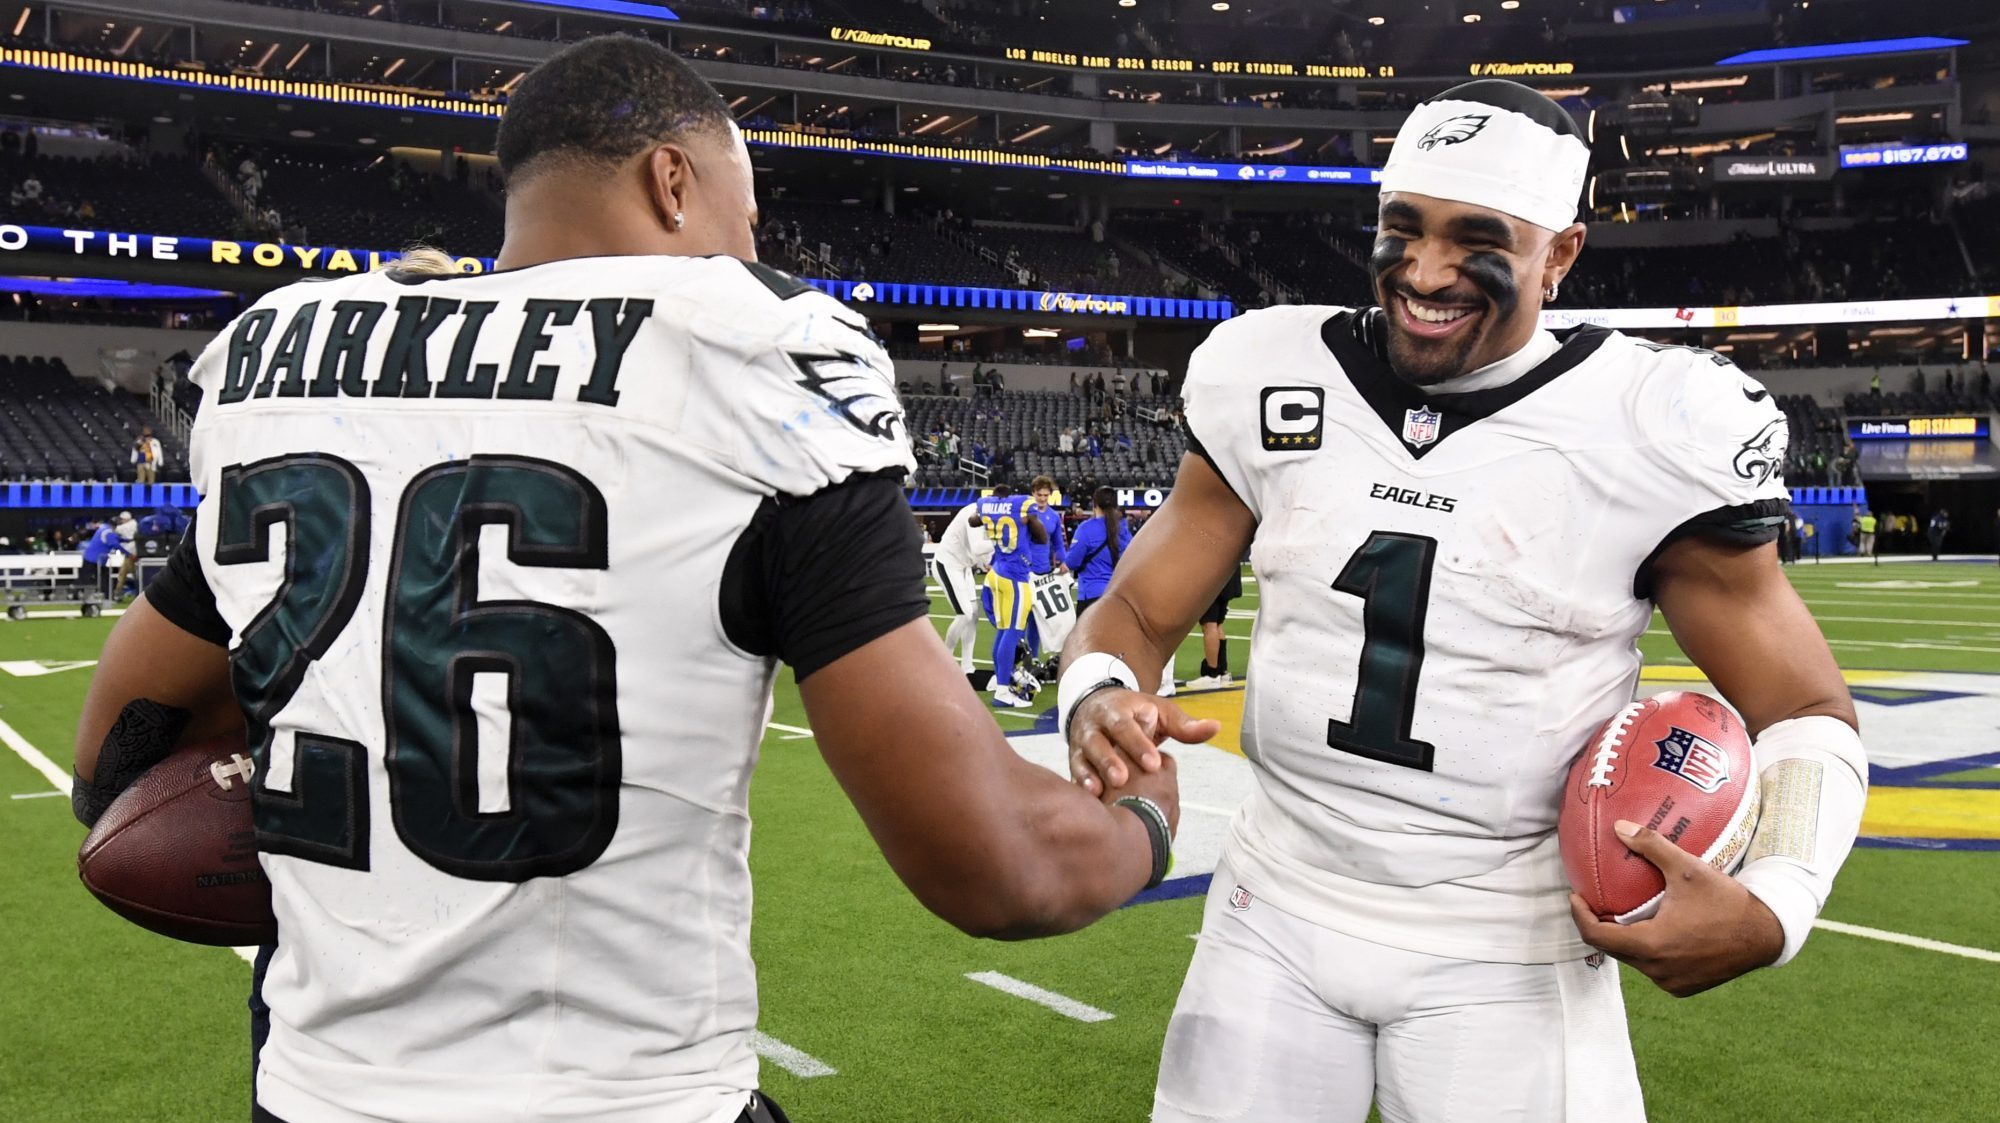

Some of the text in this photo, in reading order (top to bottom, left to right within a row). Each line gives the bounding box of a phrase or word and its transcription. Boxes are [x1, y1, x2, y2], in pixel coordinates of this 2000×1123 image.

[1006, 47, 1394, 78] LOS ANGELES RAMS 2024 SEASON SOFI STADIUM, INGLEWOOD, CA
[1776, 162, 1816, 175] ULTRA
[63, 229, 178, 260] THE
[1561, 313, 1609, 325] Scores
[218, 295, 655, 407] BARKLEY
[1265, 391, 1320, 434] C
[1410, 424, 1432, 440] NFL
[981, 503, 1013, 515] WALLACE
[1369, 482, 1458, 512] EAGLES
[1036, 583, 1070, 620] 16
[1327, 530, 1438, 773] 1
[213, 452, 623, 884] 26
[1683, 743, 1722, 785] NFL
